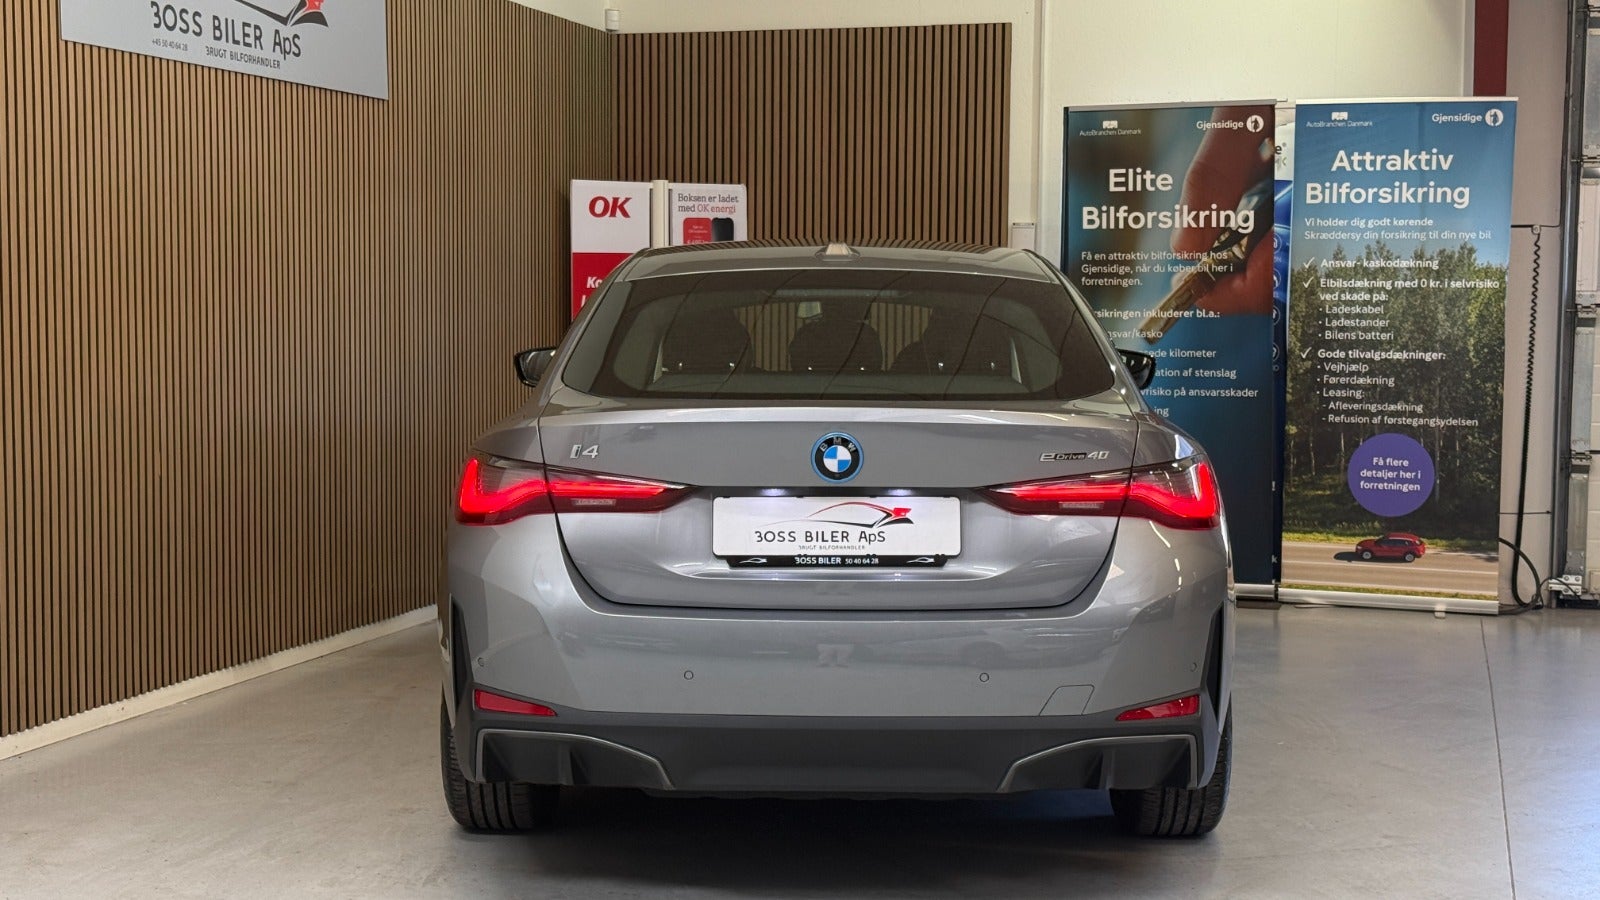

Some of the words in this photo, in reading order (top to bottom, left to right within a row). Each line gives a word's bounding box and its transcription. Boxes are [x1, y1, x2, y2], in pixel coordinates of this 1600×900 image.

[212, 15, 263, 50] BILER
[273, 28, 302, 60] ApS
[230, 51, 281, 69] BILFORHANDLER
[1432, 113, 1482, 124] Gjensidige
[1196, 120, 1244, 132] Gjensidige
[1331, 148, 1454, 171] Attraktiv
[1109, 167, 1173, 192] Elite
[678, 193, 706, 203] Boksen
[718, 194, 739, 203] ladet
[1306, 181, 1470, 209] Bilforsikring
[589, 196, 632, 218] OK
[678, 204, 696, 212] med
[697, 204, 710, 212] OK
[710, 205, 736, 214] energi
[1082, 204, 1254, 233] Bilforsikring
[1305, 218, 1314, 226] Vi
[1317, 218, 1348, 226] holder
[1350, 218, 1366, 228] dig
[1368, 218, 1391, 228] godt
[1393, 218, 1433, 226] kørende
[1304, 230, 1361, 241] Skræddersy
[1363, 231, 1378, 239] din
[1381, 230, 1426, 241] forsikring
[1428, 231, 1438, 239] til
[1440, 231, 1456, 239] din
[1458, 232, 1476, 241] nye
[1478, 231, 1491, 239] bil
[1082, 251, 1093, 260] Få
[1108, 252, 1149, 260] attraktiv
[1151, 251, 1207, 262] bilforsikring
[1210, 251, 1228, 260] hos
[1082, 264, 1133, 275] Gjensidige,
[1136, 264, 1151, 273] når
[1153, 264, 1165, 273] du
[1167, 264, 1195, 273] køber
[1197, 264, 1210, 273] bil
[1211, 264, 1228, 273] her
[1230, 264, 1233, 273] i
[1321, 260, 1361, 268] Ansvar-
[1363, 259, 1439, 269] kaskodækning
[1082, 277, 1142, 287] forretningen.
[1320, 279, 1392, 289] Elbilsdækning
[1394, 279, 1418, 288] med
[1420, 279, 1426, 288] 0
[1429, 279, 1443, 288] kr.
[1445, 279, 1448, 288] i
[1450, 279, 1499, 288] selvrisiko
[1320, 293, 1339, 301] ved
[1341, 293, 1370, 301] skade
[1373, 292, 1388, 302] på:
[1143, 309, 1194, 318] inkluderer
[1325, 305, 1384, 314] Ladeskabel
[1325, 318, 1390, 327] Ladestander
[1325, 331, 1356, 340] Bilens
[1358, 331, 1394, 340] batteri
[1169, 349, 1216, 358] kilometer
[1317, 349, 1345, 358] Gode
[1348, 350, 1446, 361] tilvalgsdækninger:
[1324, 362, 1369, 372] Vejhjælp
[1182, 368, 1193, 377] af
[1195, 369, 1237, 379] stenslag
[1323, 375, 1395, 387] Førerdækning
[1174, 387, 1186, 398] på
[1188, 388, 1258, 397] ansvarsskader
[1323, 389, 1364, 399] Leasing:
[1328, 402, 1423, 413] Afleveringsdækning
[1328, 414, 1369, 424] Refusion
[1371, 415, 1381, 424] af
[820, 436, 857, 452] BMW
[1087, 451, 1110, 460] 40
[1373, 457, 1384, 466] Få
[1386, 458, 1409, 467] flere
[1360, 469, 1397, 480] detaljer
[1399, 470, 1416, 479] her
[1418, 470, 1421, 479] i
[1360, 481, 1421, 492] forretningen
[805, 531, 849, 542] BILER
[858, 531, 886, 545] ApS
